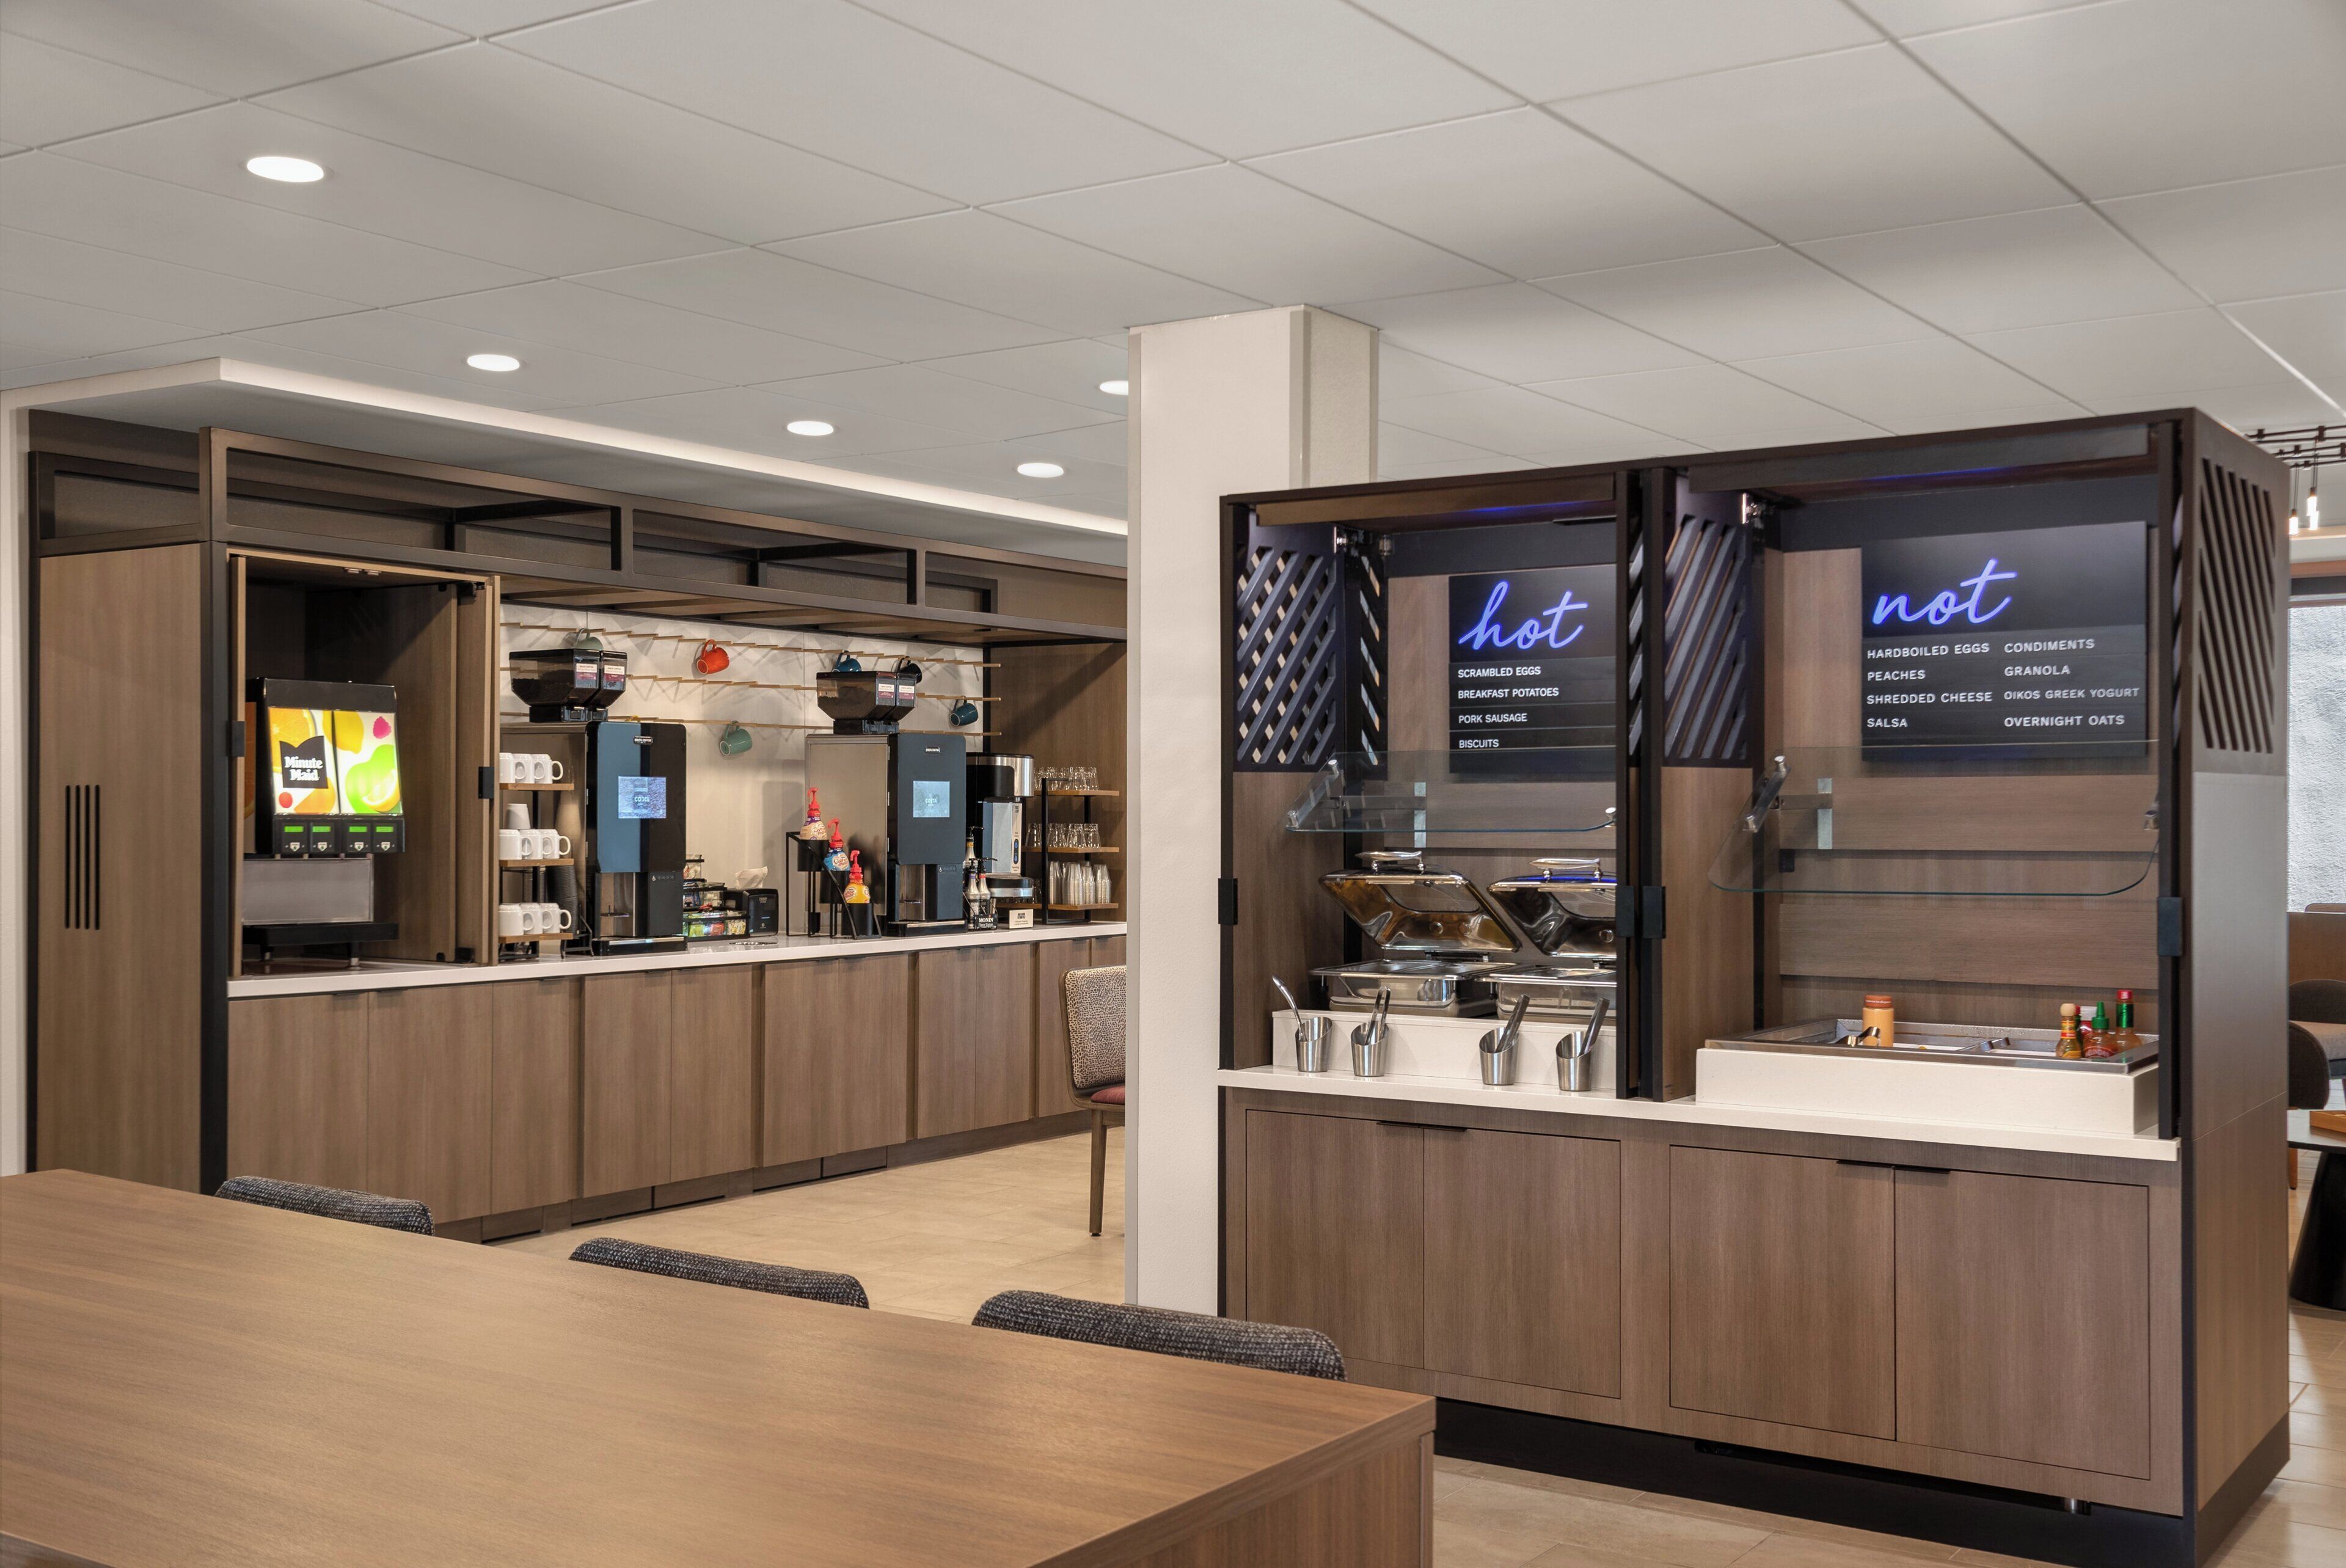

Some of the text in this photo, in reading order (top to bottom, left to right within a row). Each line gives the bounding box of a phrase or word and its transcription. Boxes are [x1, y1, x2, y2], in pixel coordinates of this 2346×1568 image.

[1872, 558, 2017, 625] not
[1458, 580, 1588, 650] hot
[1867, 643, 1990, 659] HARDBOILED EGGS
[2004, 639, 2095, 653] CONDIMENTS
[1458, 666, 1541, 678] SCRAMBLED EGGS
[1868, 669, 1926, 681] PEACHES
[2004, 665, 2070, 676] GRANOLA
[1458, 687, 1559, 699] BREAKFAST POTATOES
[1866, 691, 1993, 704] SHREDDED CHEESE
[2004, 688, 2140, 700] OIKOS GREEK YOGURT
[1458, 713, 1527, 724] PORK SAUSAGE
[1867, 718, 1908, 727] SALSA
[2004, 715, 2125, 727] OVERNIGHT OATS
[1459, 739, 1499, 748] BISCUITS
[284, 756, 323, 769] Minute
[290, 769, 320, 781] Maid
